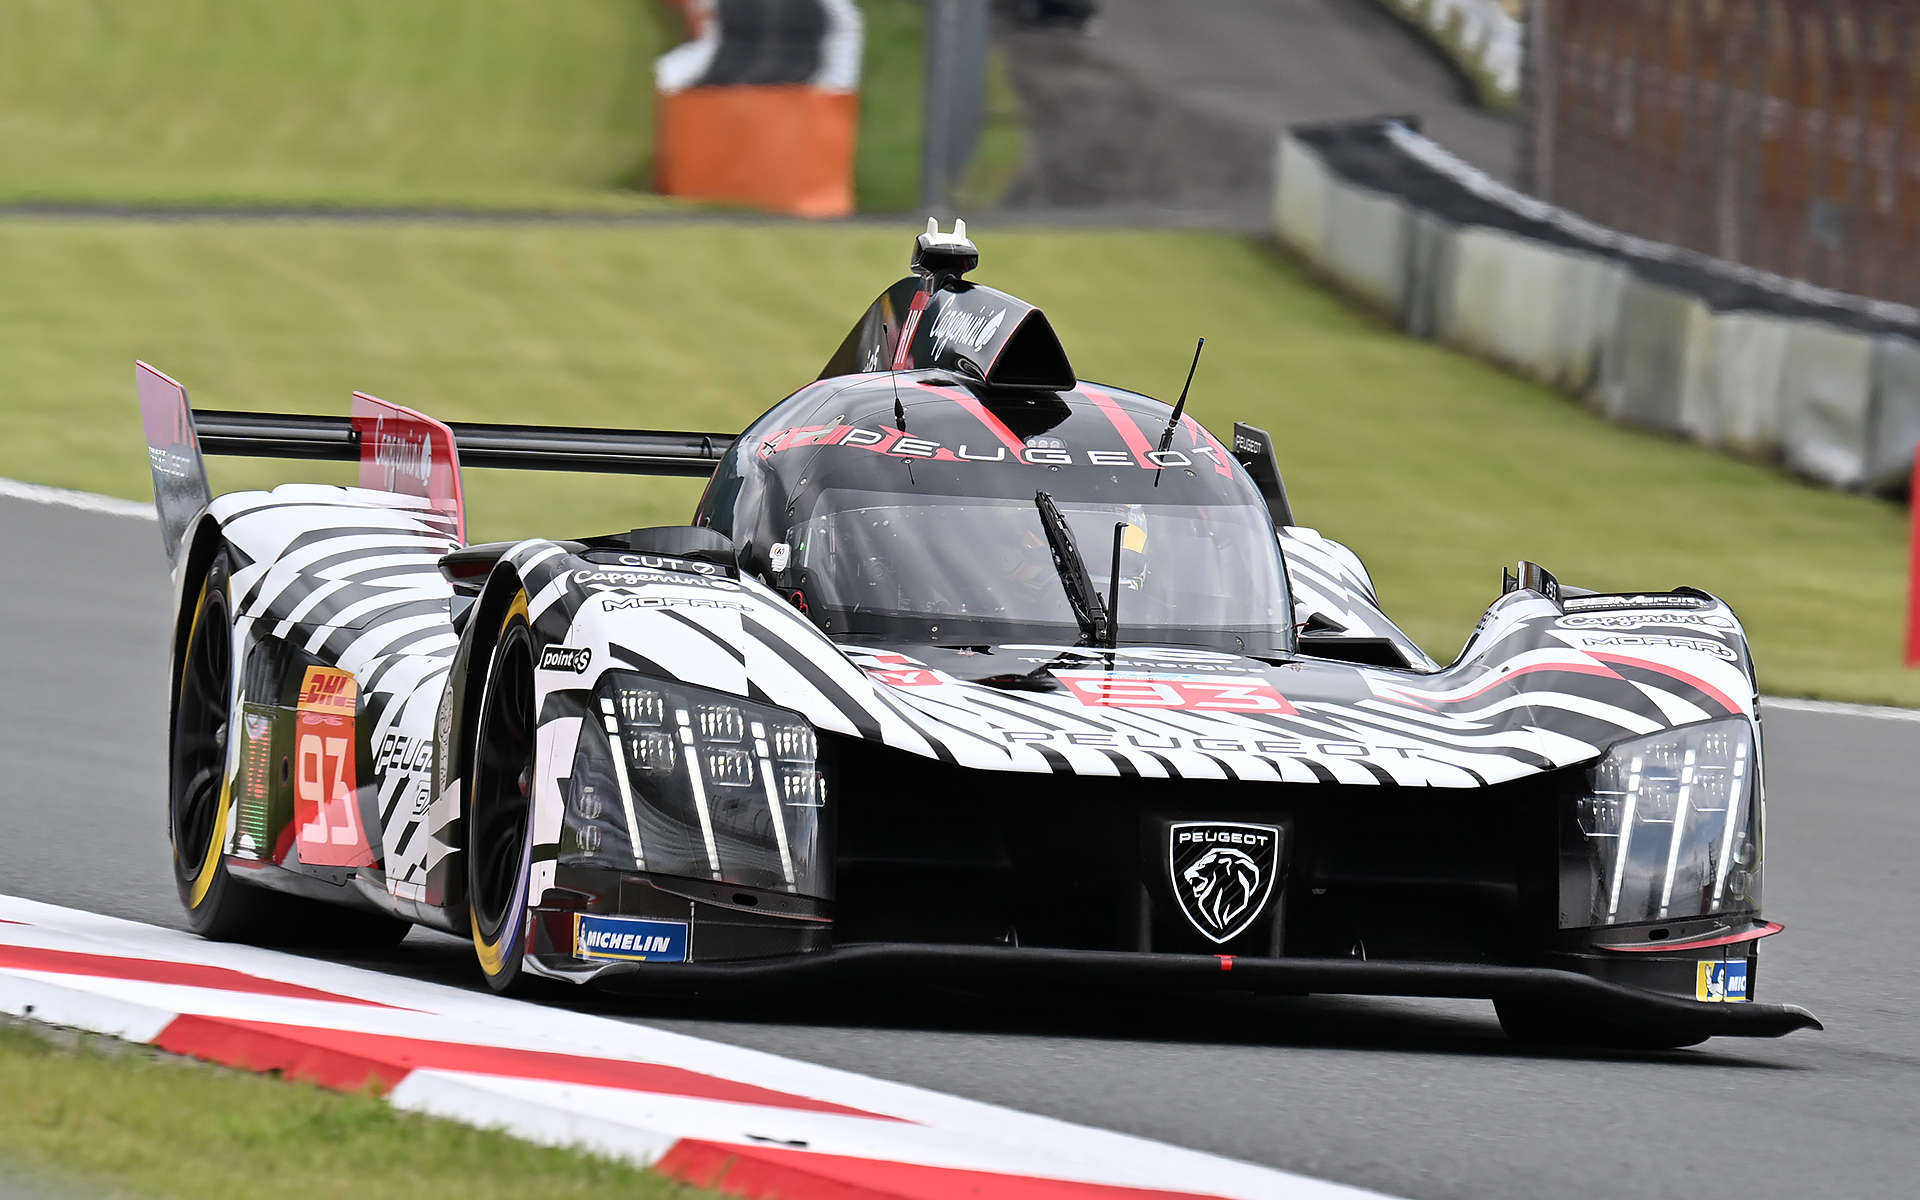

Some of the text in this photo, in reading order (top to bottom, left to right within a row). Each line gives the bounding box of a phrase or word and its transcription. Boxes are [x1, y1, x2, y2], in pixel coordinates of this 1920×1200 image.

[839, 428, 1222, 467] PEUGEOT
[1236, 434, 1262, 454] PEUGEOT
[618, 555, 684, 570] CUT
[573, 569, 711, 588] Capgemini
[603, 596, 745, 613] MOPAR
[1567, 613, 1703, 627] Capgemini
[1583, 637, 1722, 653] MOPAR
[543, 650, 573, 669] point
[1018, 657, 1266, 673] TotalEnergies
[306, 674, 348, 706] DHL
[1074, 679, 1282, 710] 93
[1006, 731, 1425, 758] PEUGEOT
[298, 733, 359, 846] 93
[1178, 831, 1269, 846] PEUGEOT
[586, 930, 671, 953] MICHELIN
